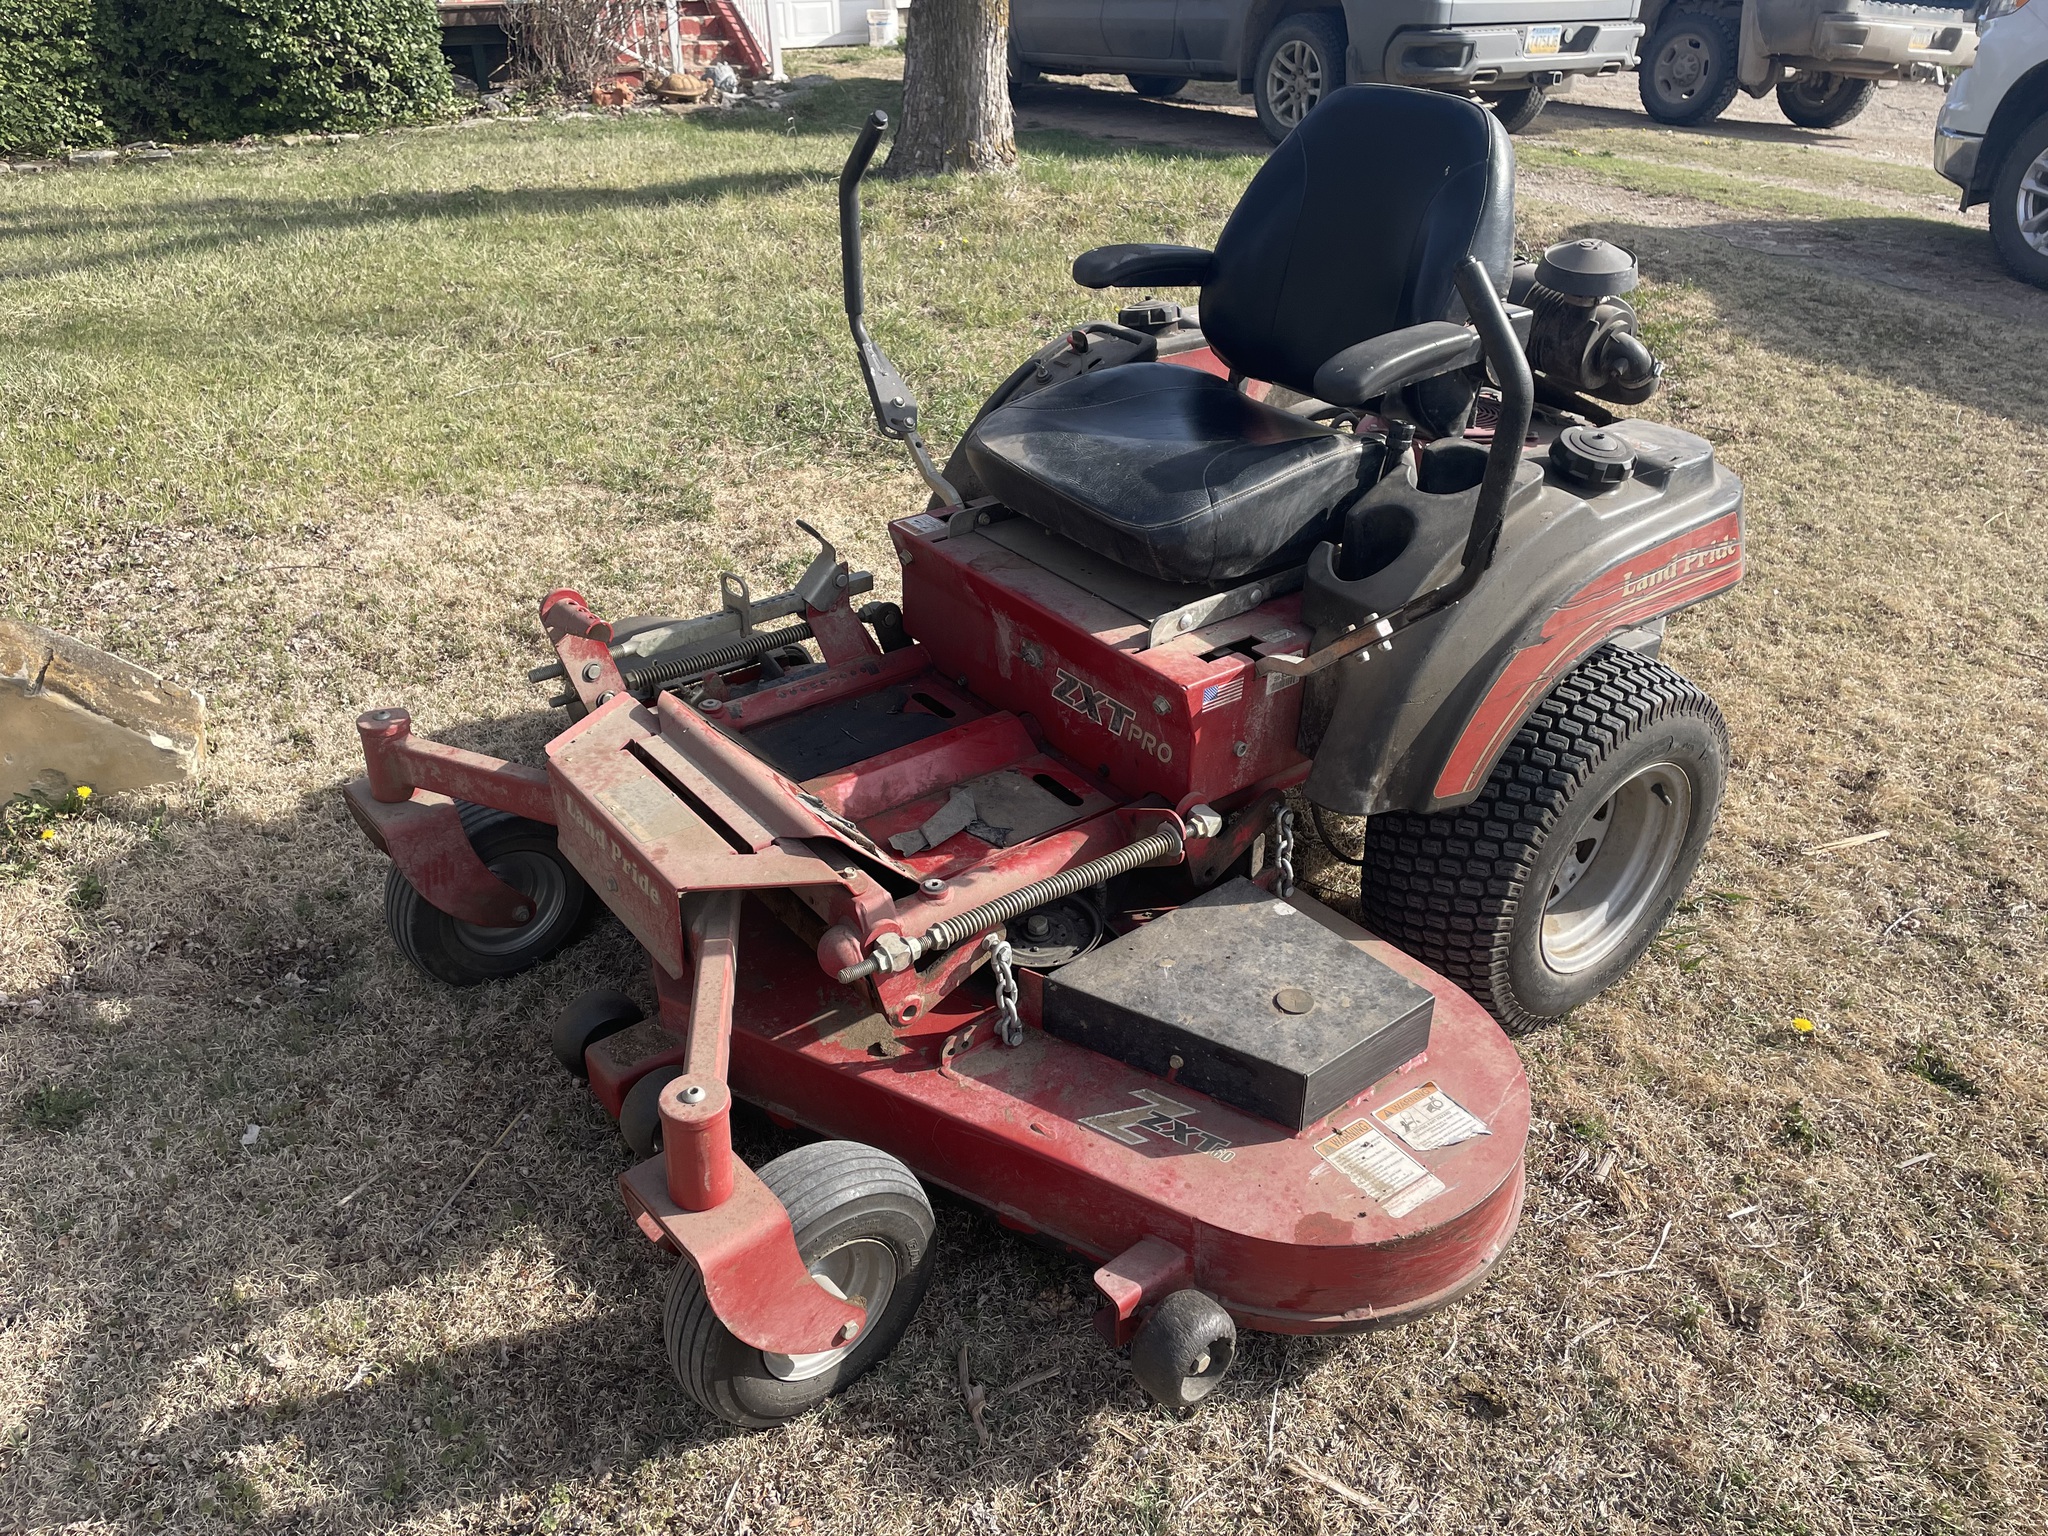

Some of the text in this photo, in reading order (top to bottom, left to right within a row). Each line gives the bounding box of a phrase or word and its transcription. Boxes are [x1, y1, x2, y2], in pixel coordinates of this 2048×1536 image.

[1621, 535, 1737, 598] Land Pride
[1051, 667, 1173, 764] ZXT PRO
[564, 794, 607, 851] Land
[611, 838, 661, 905] Pride
[1391, 1088, 1431, 1112] WARNING
[1136, 1109, 1231, 1153] ZXT
[1330, 1122, 1369, 1147] WARNING
